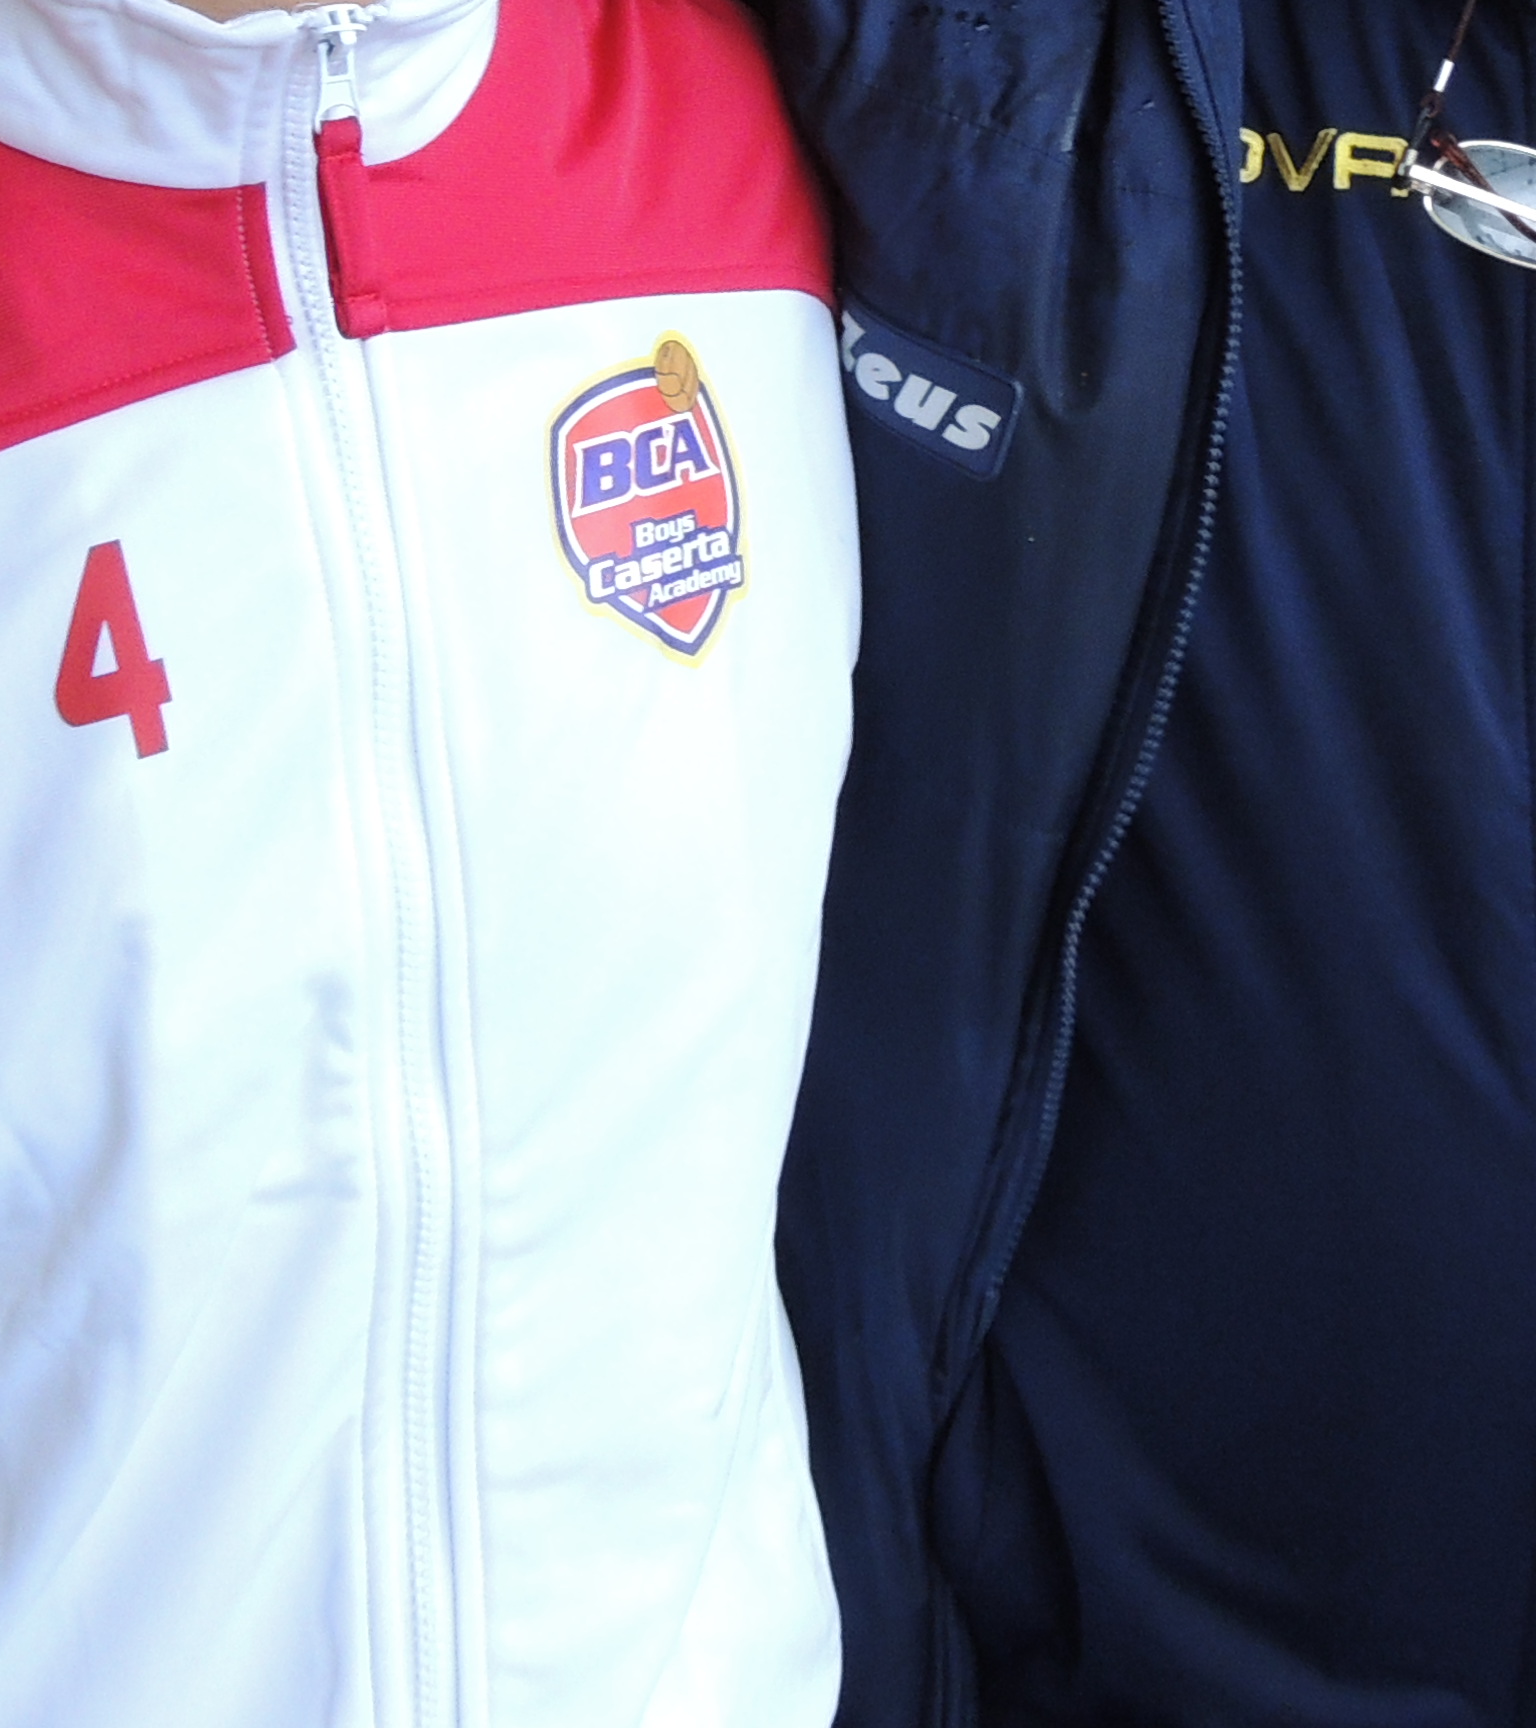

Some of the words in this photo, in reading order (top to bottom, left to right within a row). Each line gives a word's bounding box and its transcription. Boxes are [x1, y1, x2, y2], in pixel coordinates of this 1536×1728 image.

[577, 416, 715, 512] BCA
[587, 530, 731, 599] Caserta
[634, 514, 696, 549] Boys
[648, 558, 741, 608] Academy
[54, 538, 173, 760] 4
